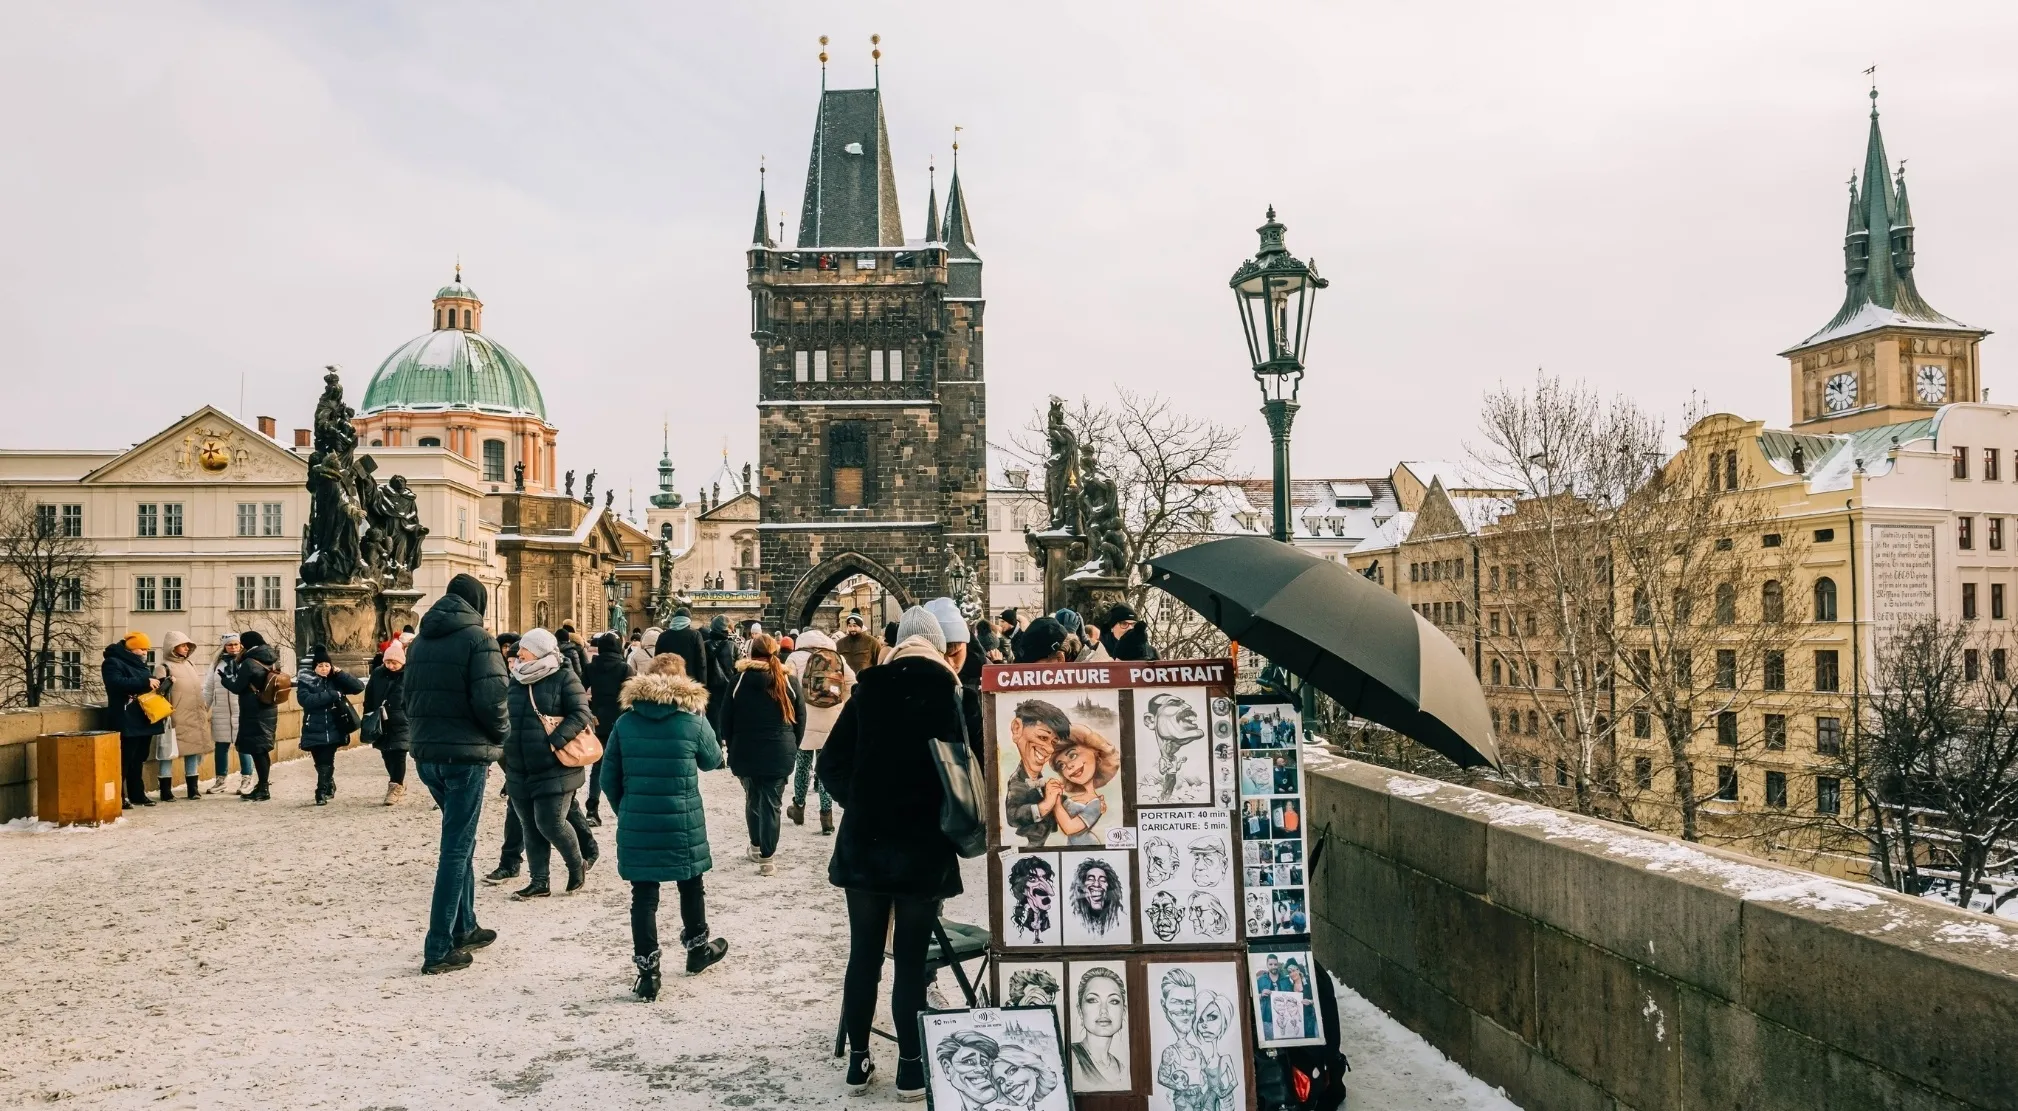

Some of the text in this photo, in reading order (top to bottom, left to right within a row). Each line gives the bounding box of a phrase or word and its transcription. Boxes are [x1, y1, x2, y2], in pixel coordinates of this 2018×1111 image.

[997, 669, 1110, 687] CARICATURE
[1130, 665, 1224, 683] PORTRAIT
[1140, 810, 1228, 820] PORTRAIT: 40 min.
[1141, 822, 1228, 831] CARICATURE: 5 min.
